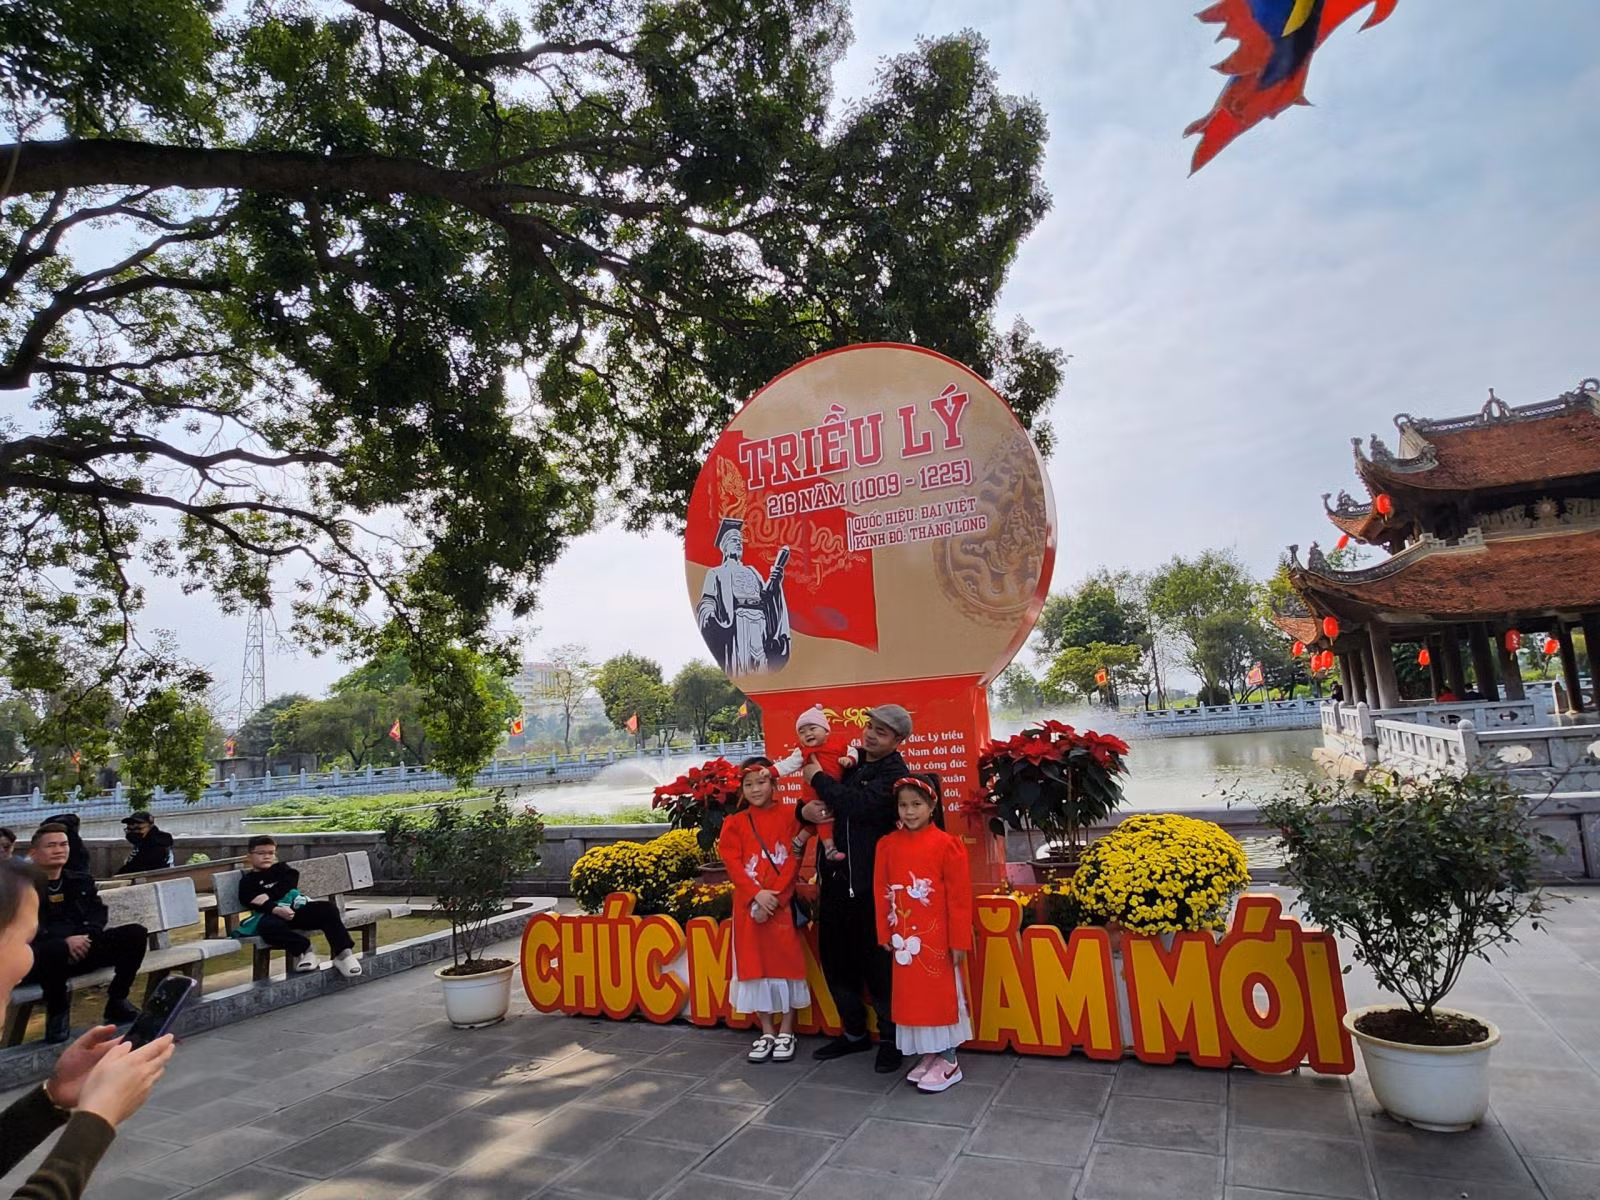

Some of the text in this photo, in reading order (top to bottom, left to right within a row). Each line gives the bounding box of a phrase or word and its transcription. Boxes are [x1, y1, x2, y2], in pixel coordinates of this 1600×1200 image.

[739, 383, 969, 490] TRIỀU LÝ
[767, 494, 799, 519] 216
[799, 481, 846, 513] NĂM
[851, 473, 901, 506] (1009
[920, 459, 974, 489] 1225)
[853, 498, 976, 531] QUỐC HIỆU: ĐẠI VIỆT
[854, 515, 988, 550] KINH ĐÔ: THĂNG LONG
[908, 747, 930, 757] Nam
[932, 745, 948, 755] đời
[950, 743, 966, 754] đời
[923, 760, 947, 771] công
[949, 759, 968, 769] đức
[941, 773, 966, 783] xuân
[523, 897, 683, 1016] CHÚC
[962, 903, 1113, 1052] ĂM
[1129, 905, 1345, 1065] MỚI
